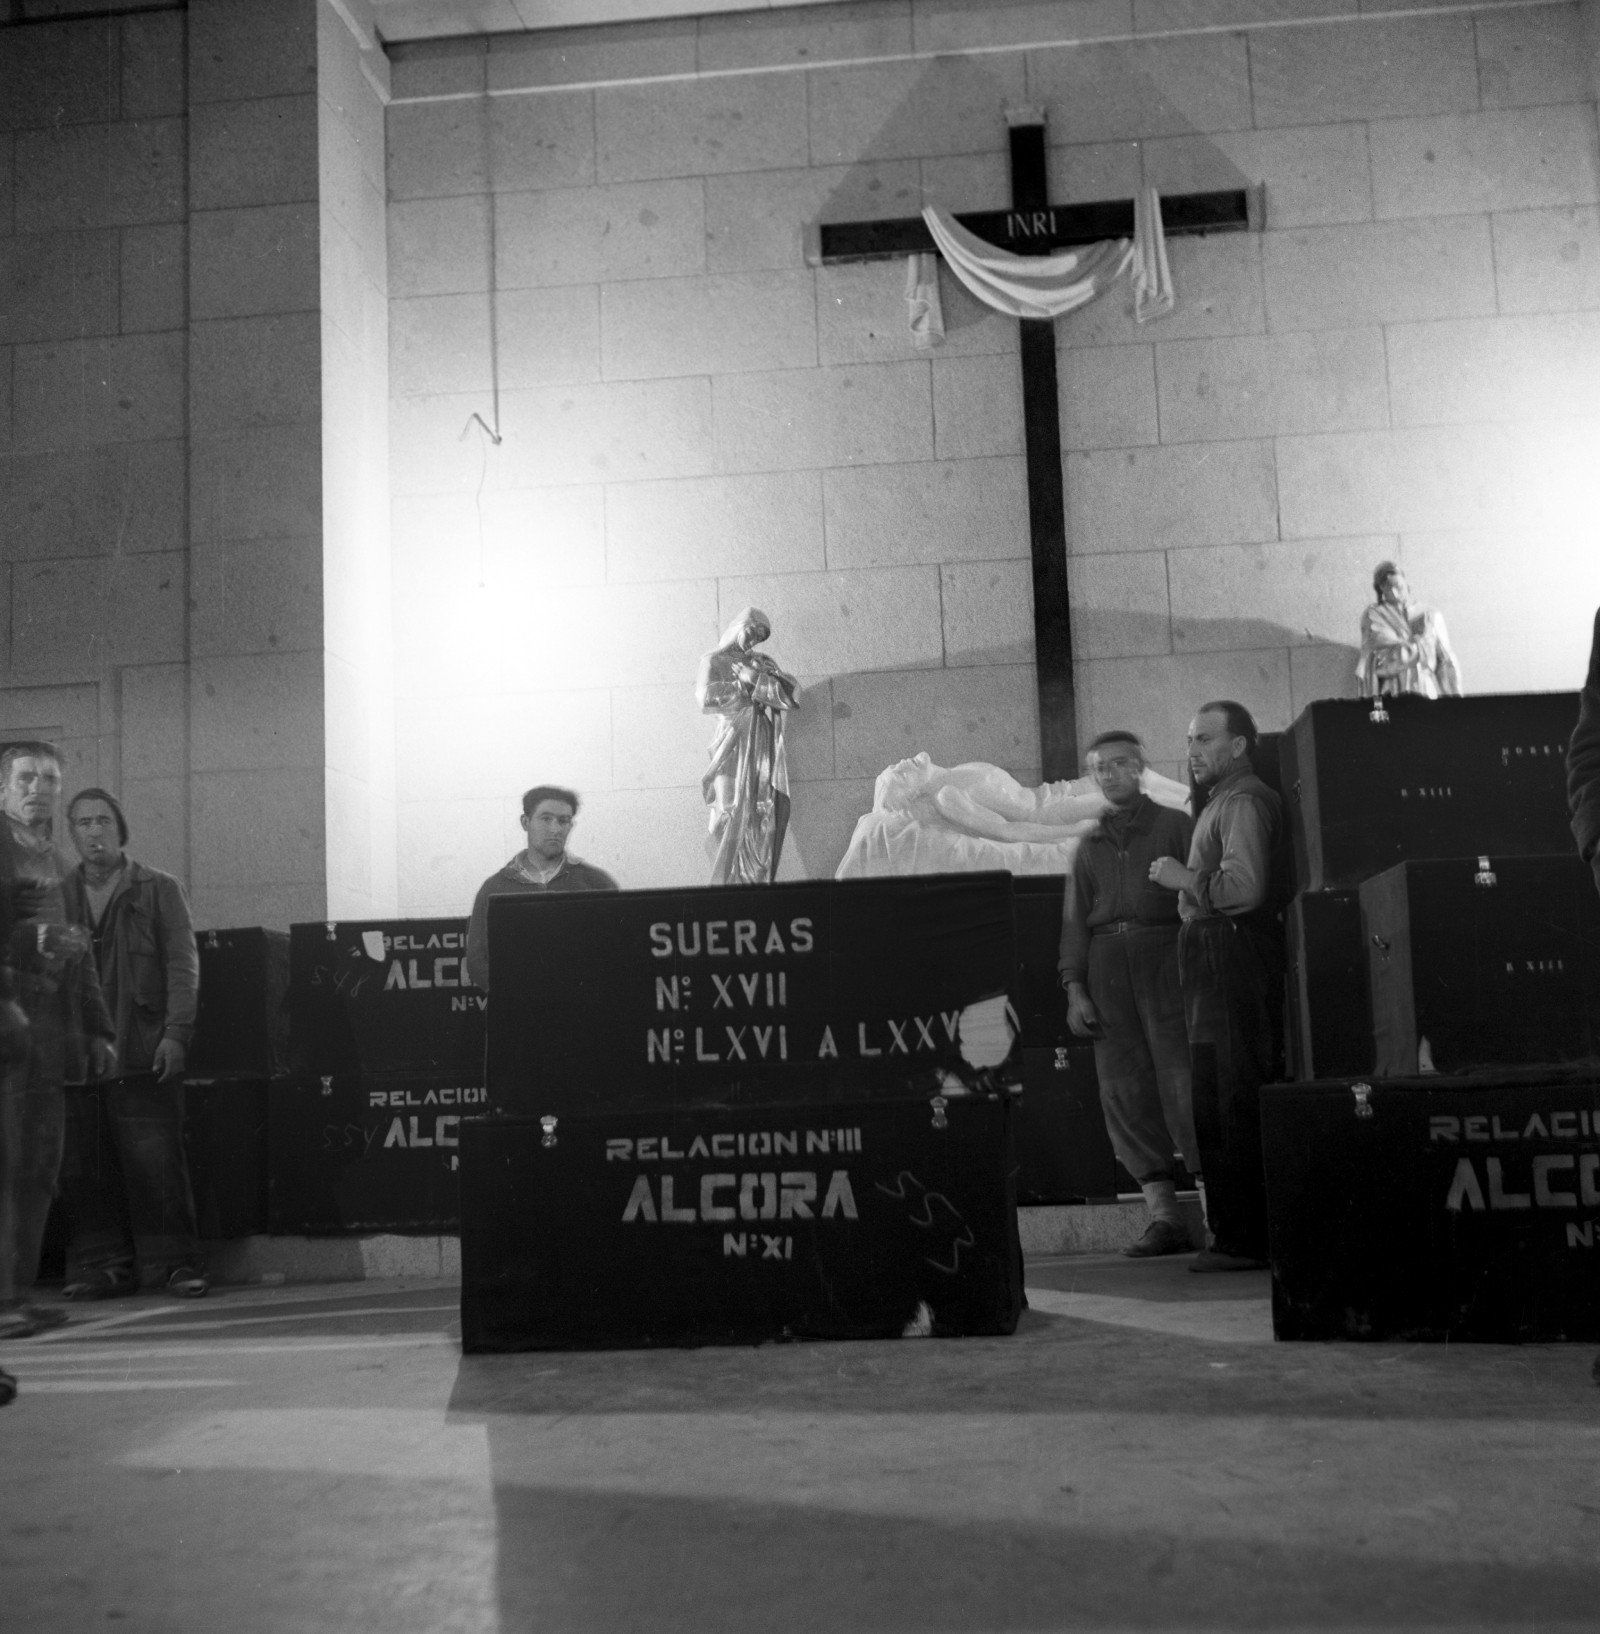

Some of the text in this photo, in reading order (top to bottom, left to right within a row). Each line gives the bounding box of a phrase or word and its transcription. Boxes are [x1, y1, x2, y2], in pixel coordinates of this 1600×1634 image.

[1007, 210, 1057, 238] INRI
[649, 917, 814, 957] SUERAS
[710, 971, 787, 1009] XVII
[695, 1024, 788, 1062] LXVI
[818, 1024, 839, 1060] A
[605, 1129, 798, 1162] RELACION
[620, 1169, 860, 1223] ALCORA
